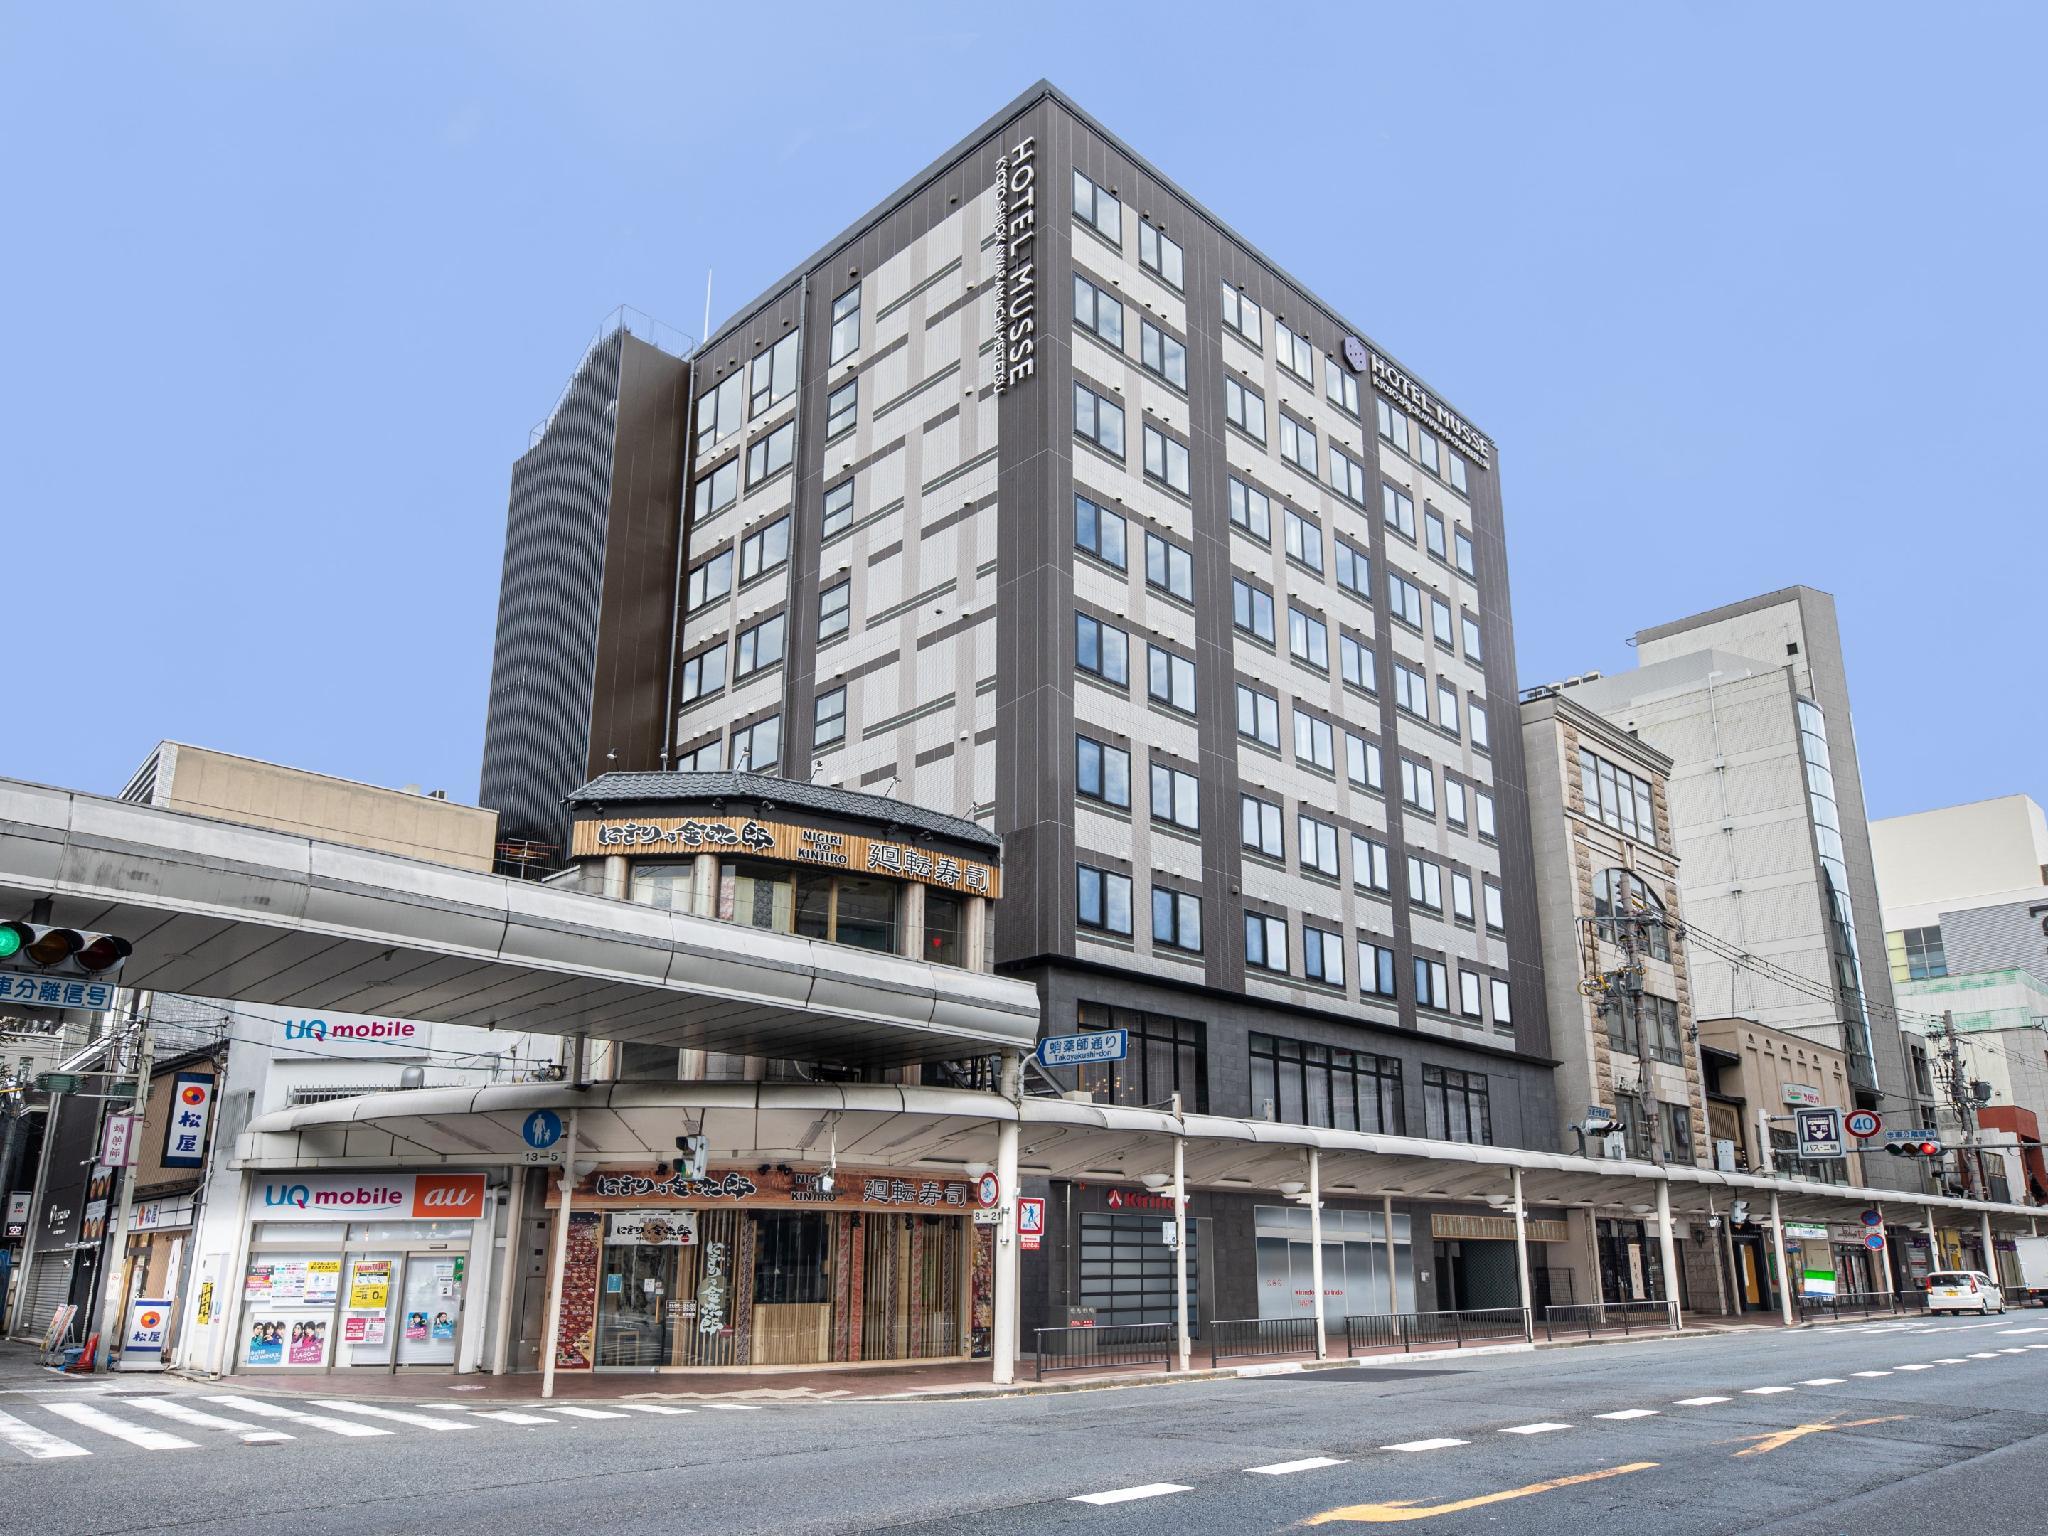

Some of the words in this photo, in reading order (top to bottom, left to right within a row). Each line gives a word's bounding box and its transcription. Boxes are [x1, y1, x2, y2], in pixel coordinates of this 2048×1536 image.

[995, 156, 1009, 199] KYOTO
[1010, 136, 1034, 258] HOTEL
[1009, 262, 1034, 385] MUSSE
[1371, 353, 1432, 413] HOTEL
[1436, 404, 1490, 458] MUSSE
[803, 830, 843, 846] NIGIRI
[814, 842, 831, 851] no
[797, 848, 847, 864] KINJIRO
[868, 843, 989, 893] 廻転寿司
[0, 976, 107, 1006] 車分離信号
[286, 1020, 327, 1041] UQ
[332, 1021, 415, 1037] mobile
[176, 1110, 202, 1152] 松屋
[1853, 1118, 1873, 1130] 40
[265, 1184, 310, 1209] UQ
[315, 1187, 403, 1205] mobile
[424, 1187, 475, 1206] au
[863, 1179, 967, 1207] 廻転寿司
[132, 1331, 161, 1343] 松屋
